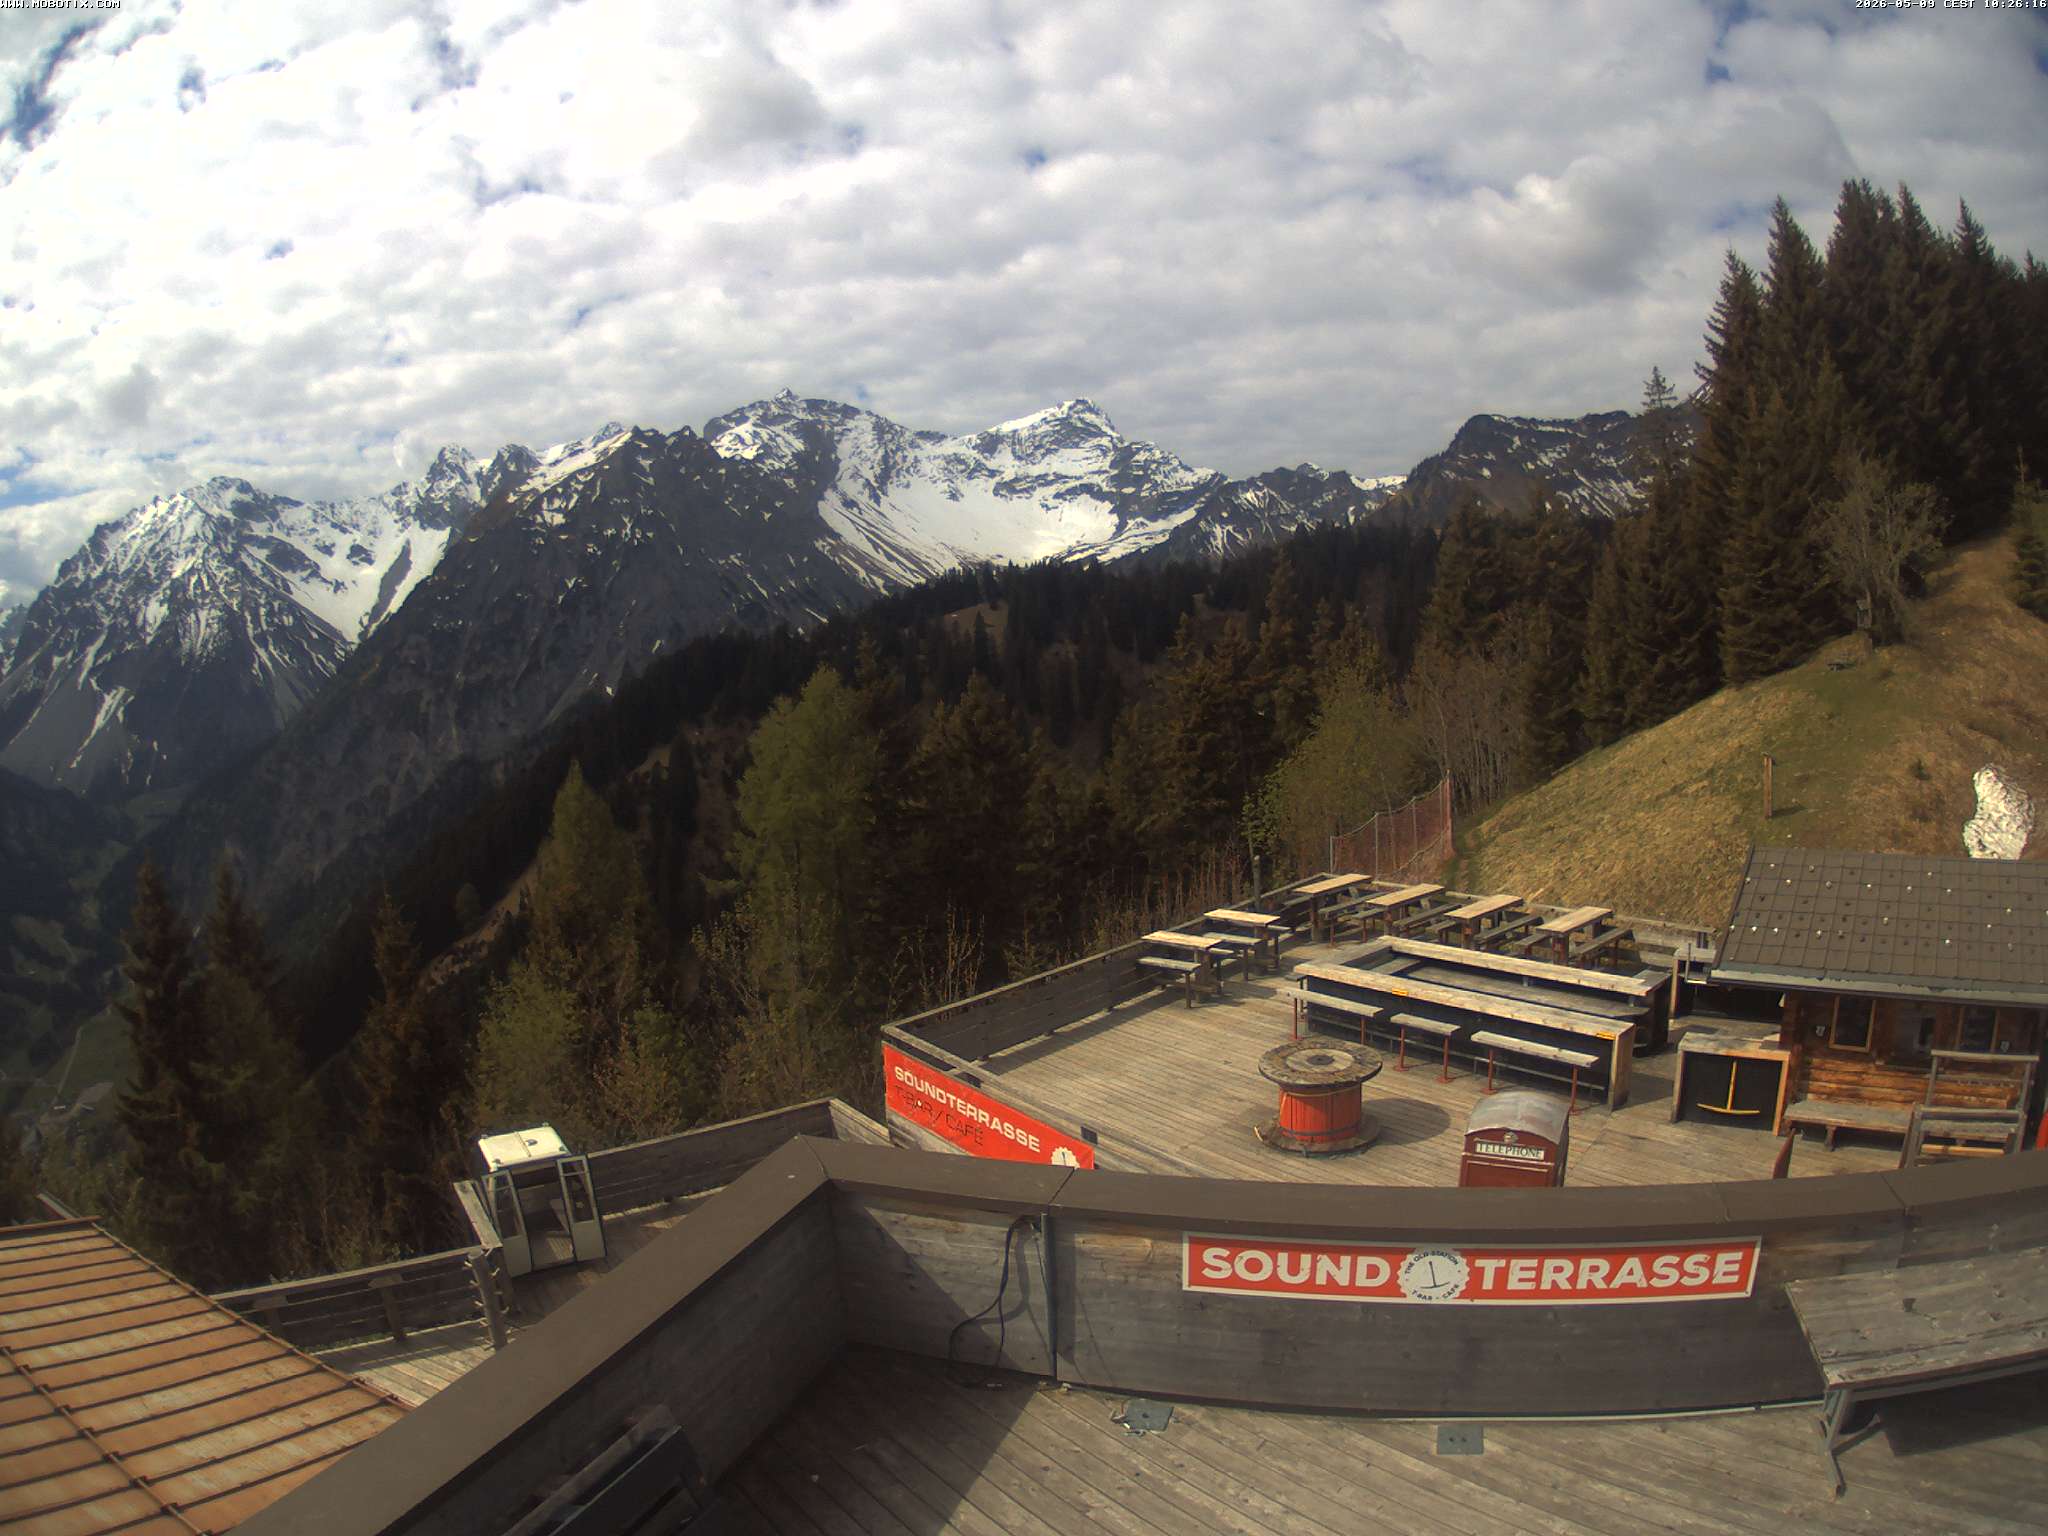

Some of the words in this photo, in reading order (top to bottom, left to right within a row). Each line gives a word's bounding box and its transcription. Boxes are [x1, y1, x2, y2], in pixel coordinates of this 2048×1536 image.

[895, 1066, 1040, 1153] SOUNDTERRASSE
[1478, 1144, 1541, 1158] TELEPHONE
[1201, 1247, 1391, 1287] SOUND
[1475, 1251, 1743, 1291] TERRASSE
